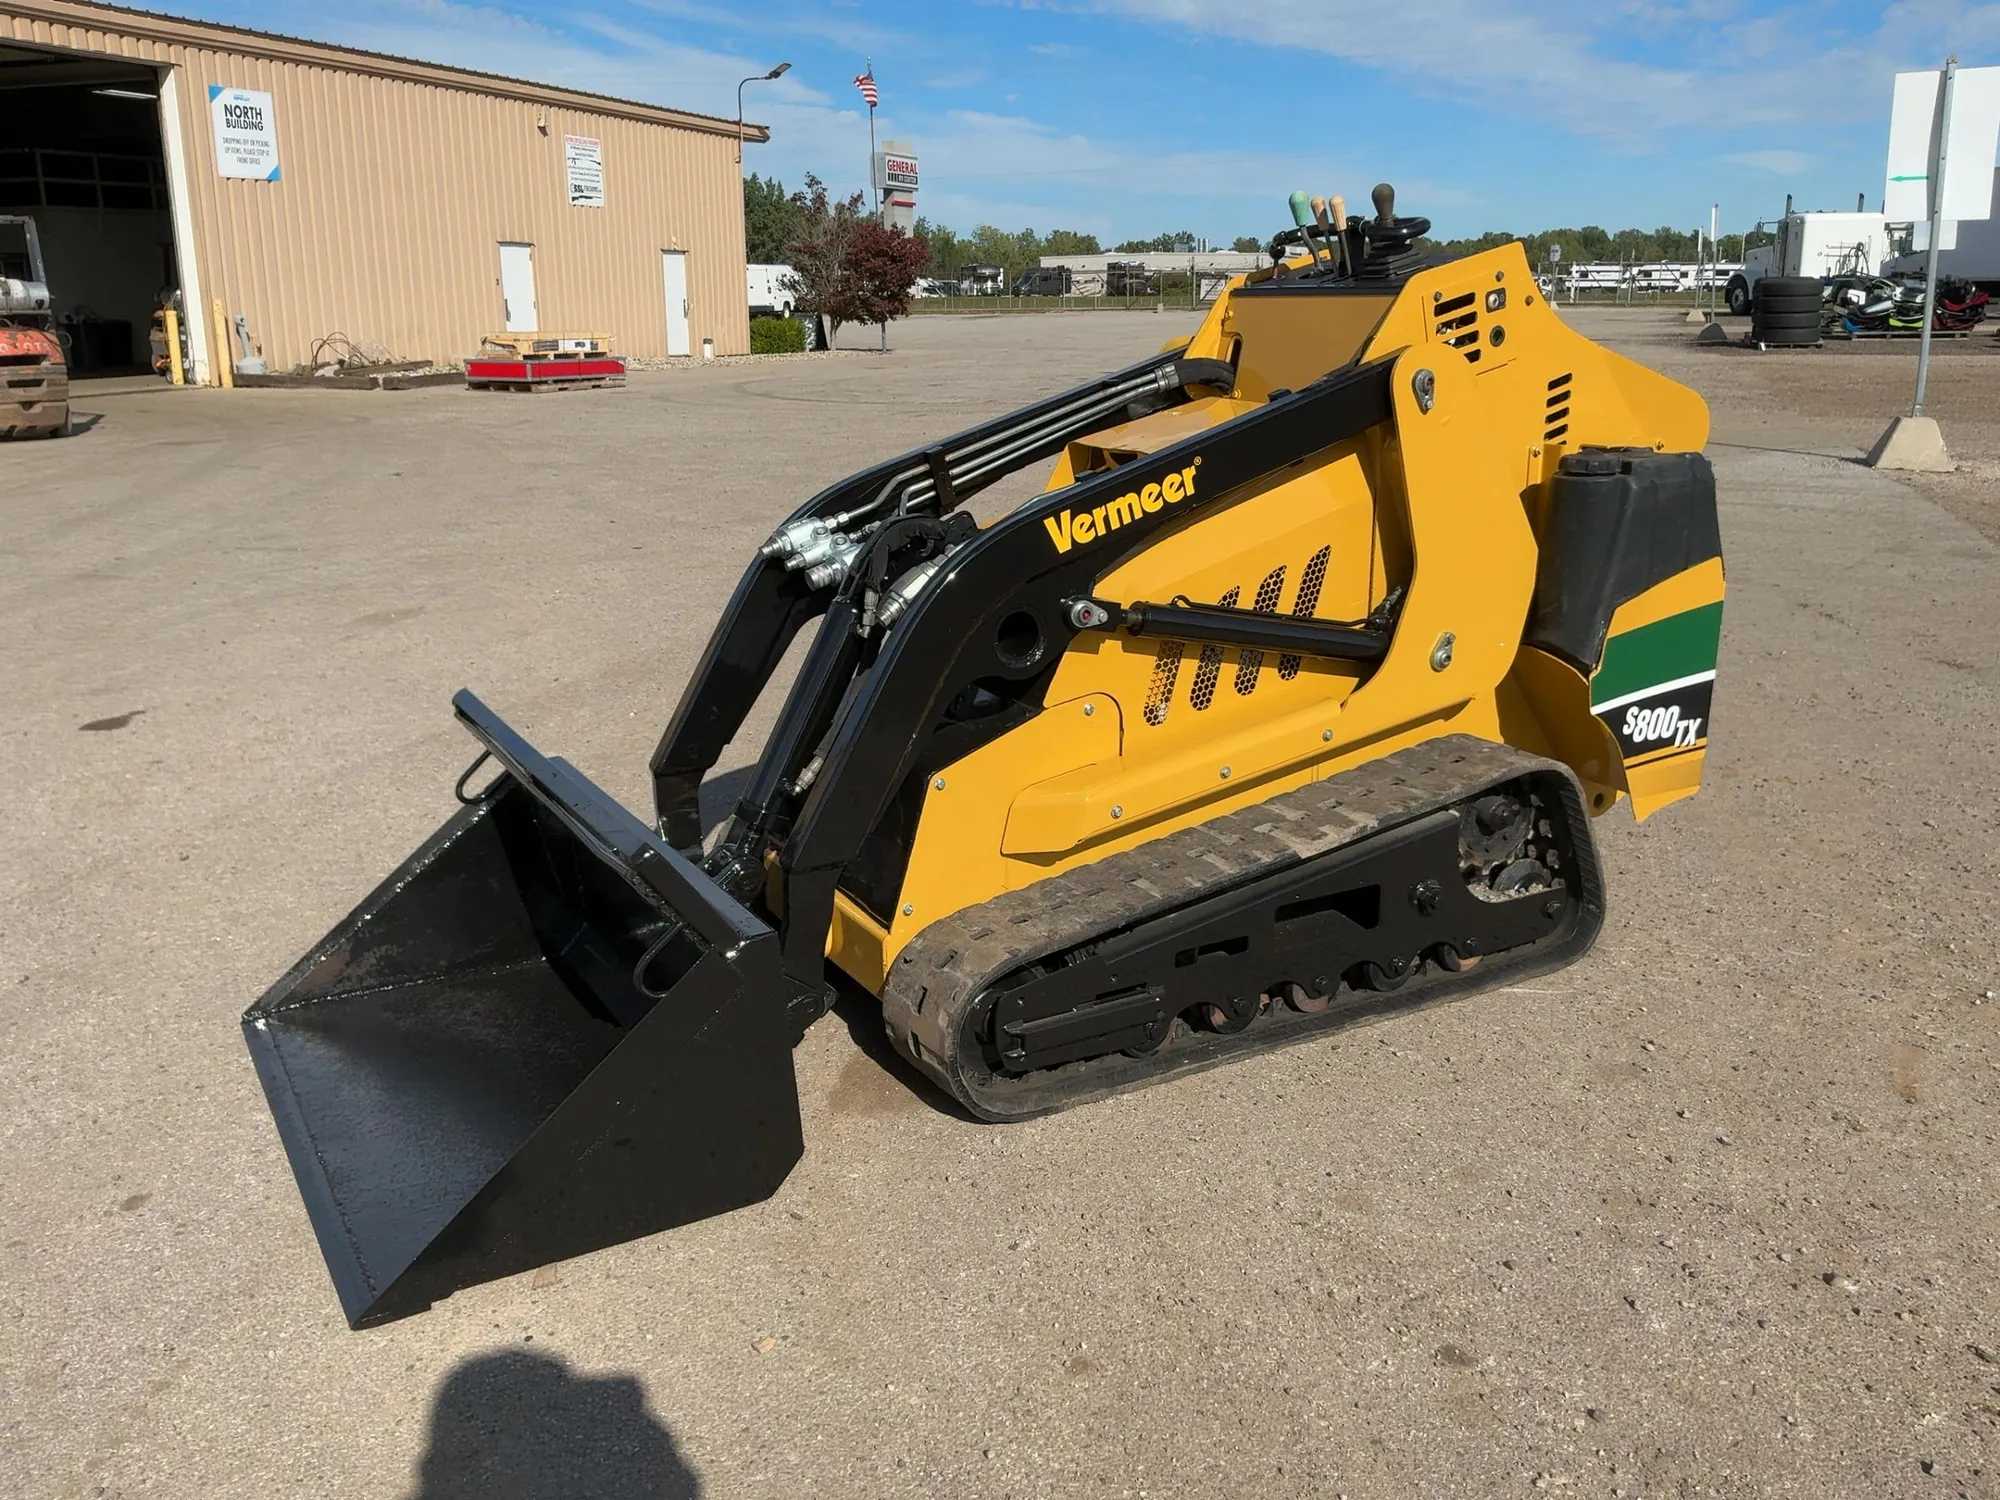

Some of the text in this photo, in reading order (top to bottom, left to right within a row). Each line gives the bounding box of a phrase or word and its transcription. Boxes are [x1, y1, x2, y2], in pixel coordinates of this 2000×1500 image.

[224, 103, 263, 121] NORTH
[225, 118, 264, 132] BUILDING
[222, 136, 242, 146] DROPPING
[887, 159, 918, 175] GENERAL
[1043, 465, 1197, 554] Vermeer
